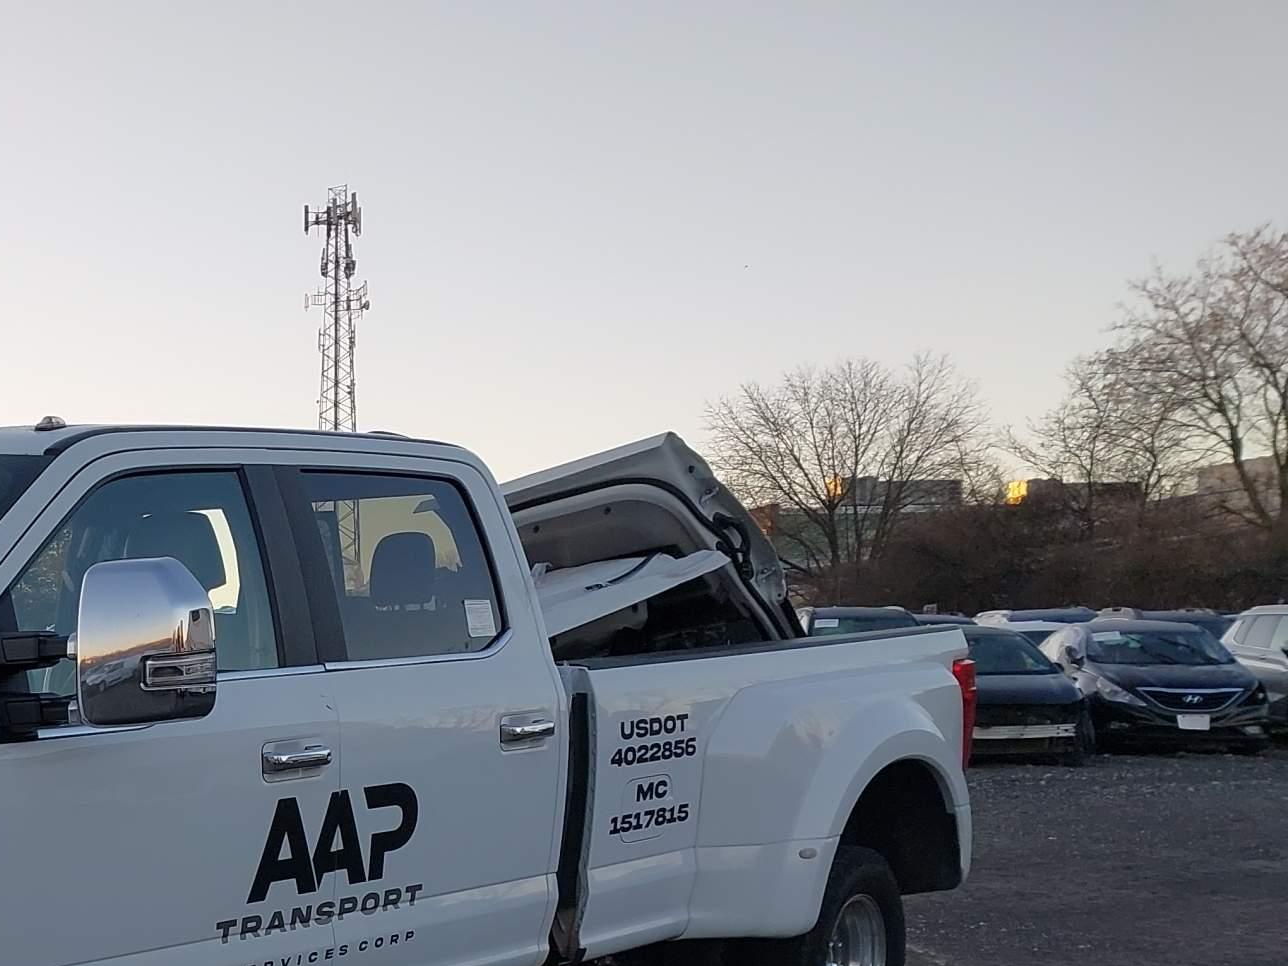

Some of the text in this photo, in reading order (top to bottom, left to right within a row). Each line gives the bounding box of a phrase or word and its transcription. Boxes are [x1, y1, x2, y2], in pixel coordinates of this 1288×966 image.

[620, 713, 689, 740] USDOT
[610, 737, 697, 767] 4022856
[636, 780, 668, 802] MC
[609, 804, 689, 835] 1517815
[246, 782, 419, 905] AAP
[216, 884, 424, 944] TRANSPORT
[358, 930, 417, 953] CORP
